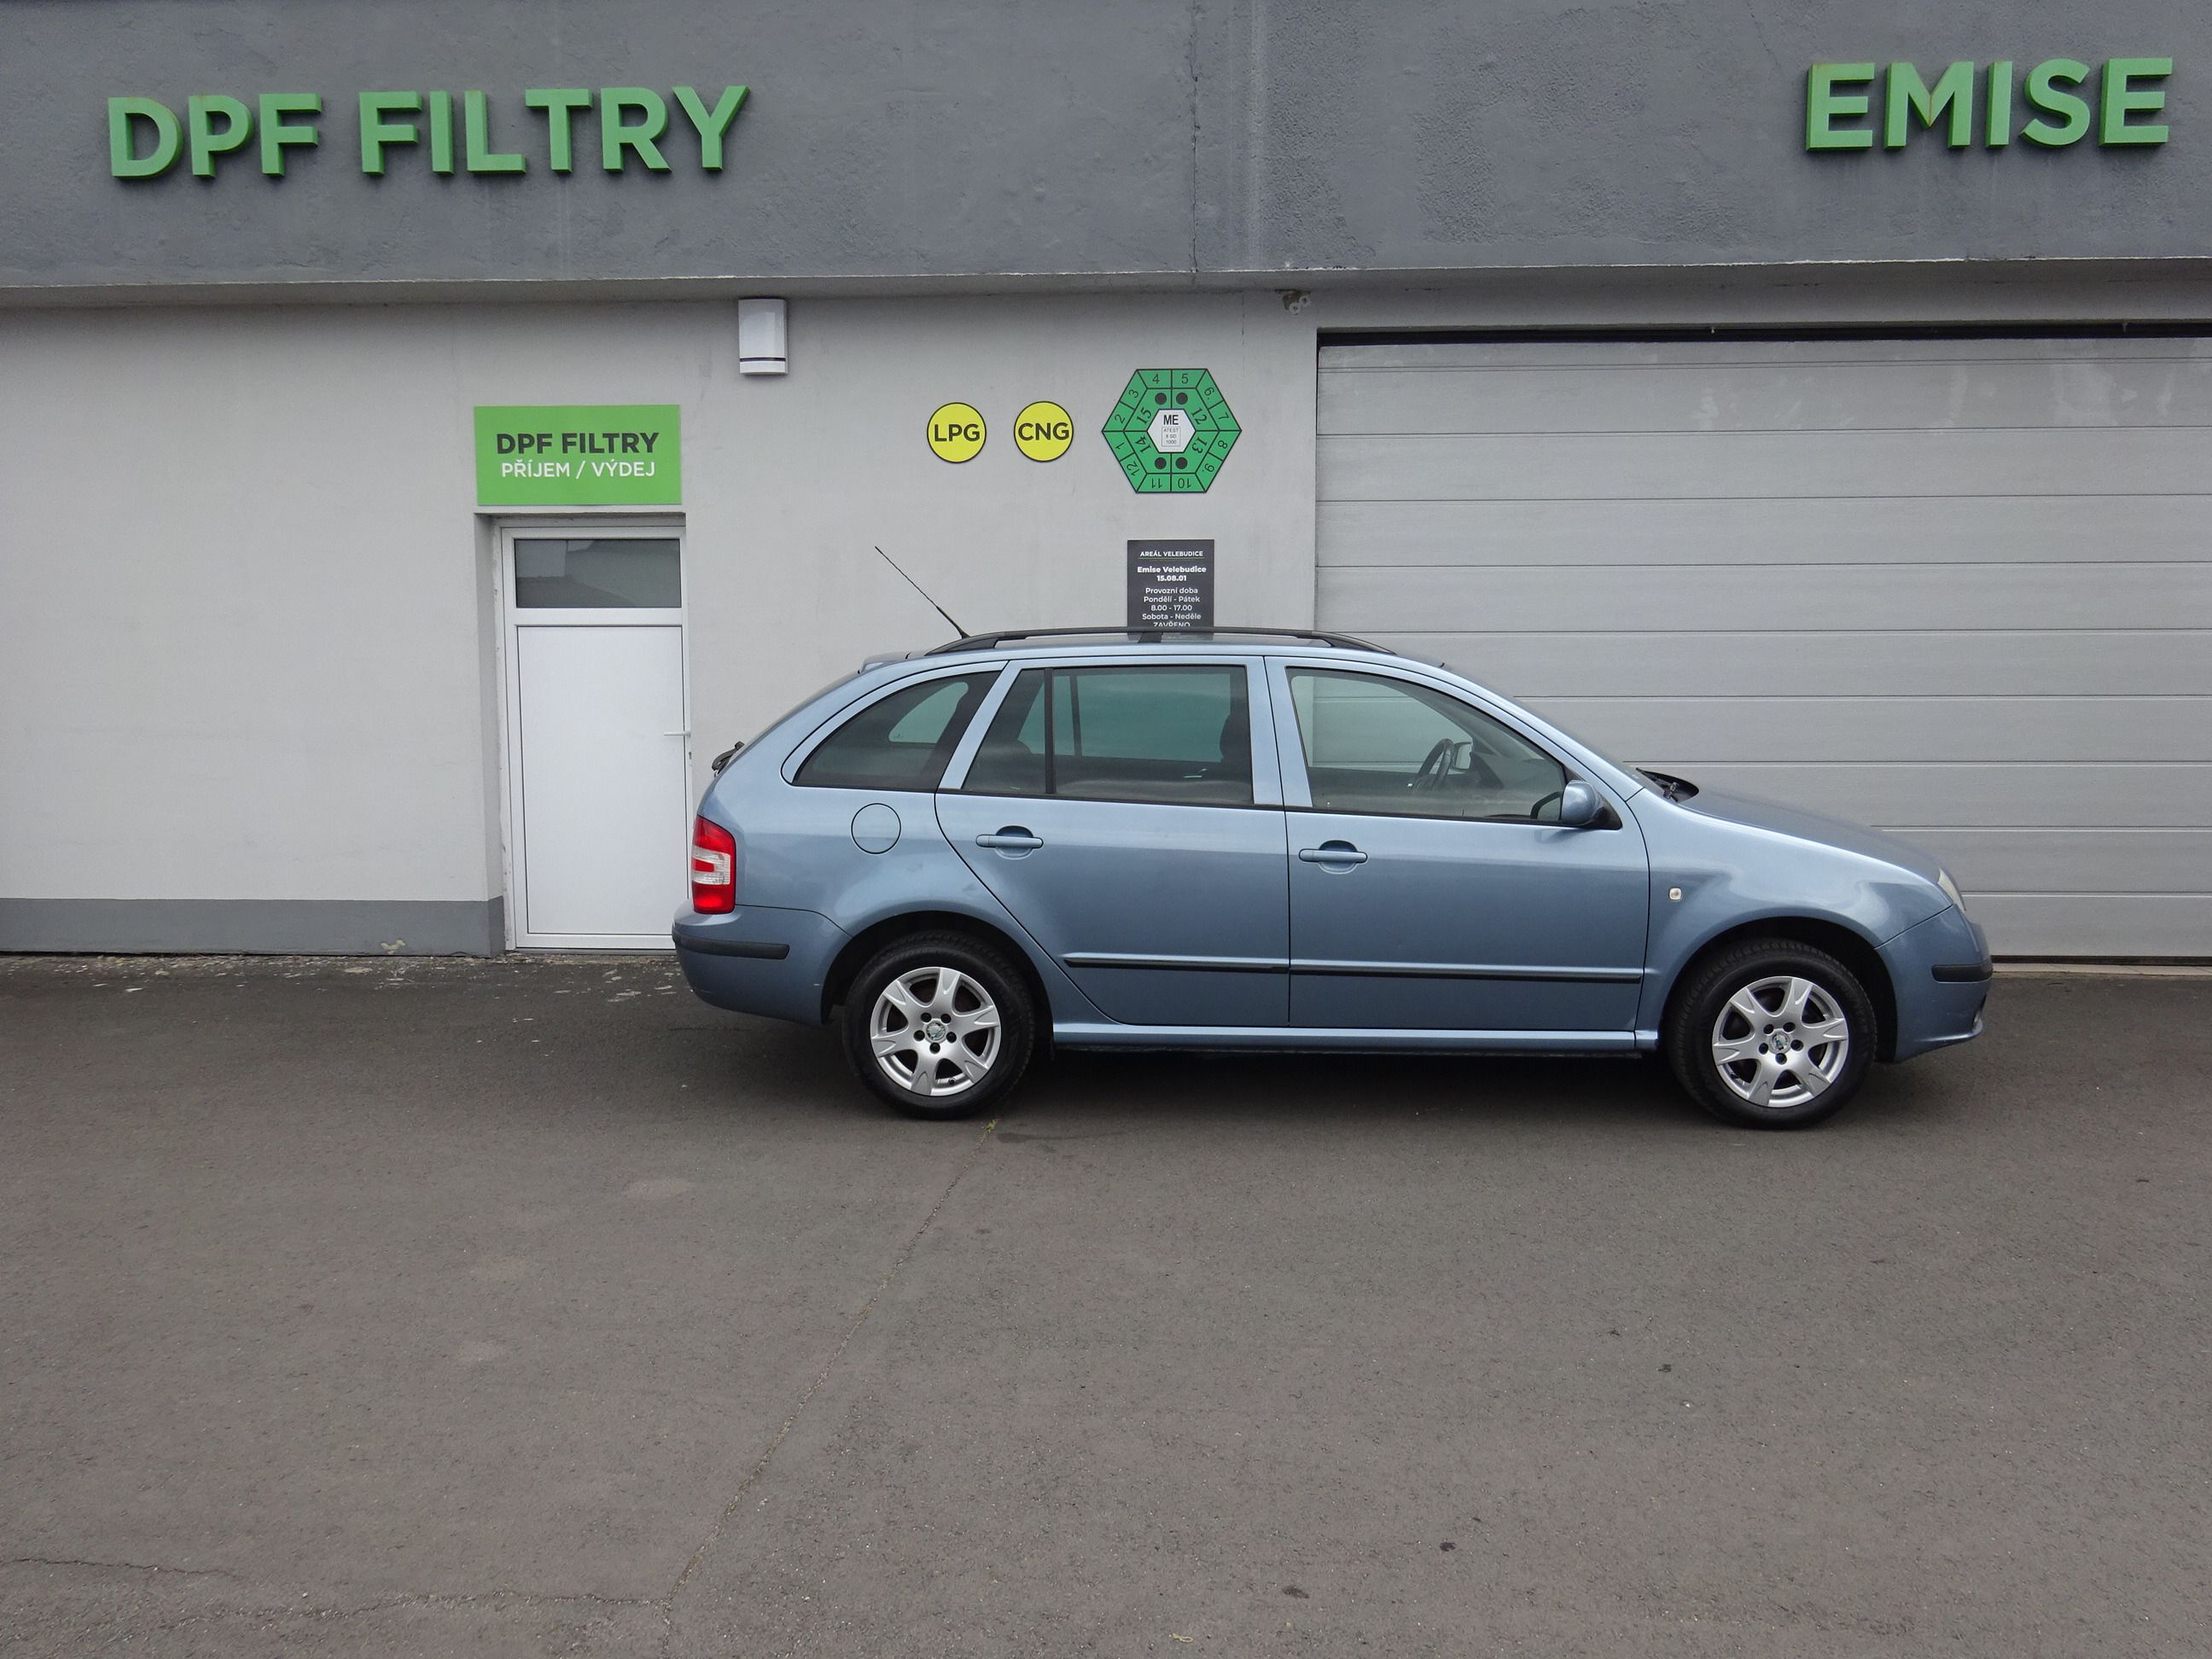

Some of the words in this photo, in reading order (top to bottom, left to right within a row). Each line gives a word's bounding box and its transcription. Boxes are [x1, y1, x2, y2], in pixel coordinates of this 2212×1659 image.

[1806, 57, 2173, 149] EMISE
[108, 92, 322, 178] DPF
[358, 85, 750, 174] FILTRY
[1152, 373, 1160, 384] 4
[1181, 373, 1189, 384] 5
[1128, 389, 1139, 399] 3
[1115, 414, 1126, 424] 2
[1136, 407, 1152, 425] 15
[1163, 414, 1179, 426] ME
[1190, 407, 1208, 425] 12
[1218, 412, 1230, 421] 7
[934, 423, 981, 442] LPG
[1018, 422, 1069, 441] CNG
[497, 433, 553, 454] DPF
[562, 432, 660, 454] FILTRY
[1115, 441, 1126, 451] 1
[1135, 435, 1151, 454] 14
[1191, 436, 1208, 454] 13
[1218, 439, 1228, 449] 8
[502, 459, 570, 477] PŘÍJEM
[575, 461, 586, 479] /
[591, 459, 655, 477] VÝDEJ
[1126, 461, 1140, 476] 12
[1151, 478, 1163, 489] 11
[1178, 478, 1191, 489] 10
